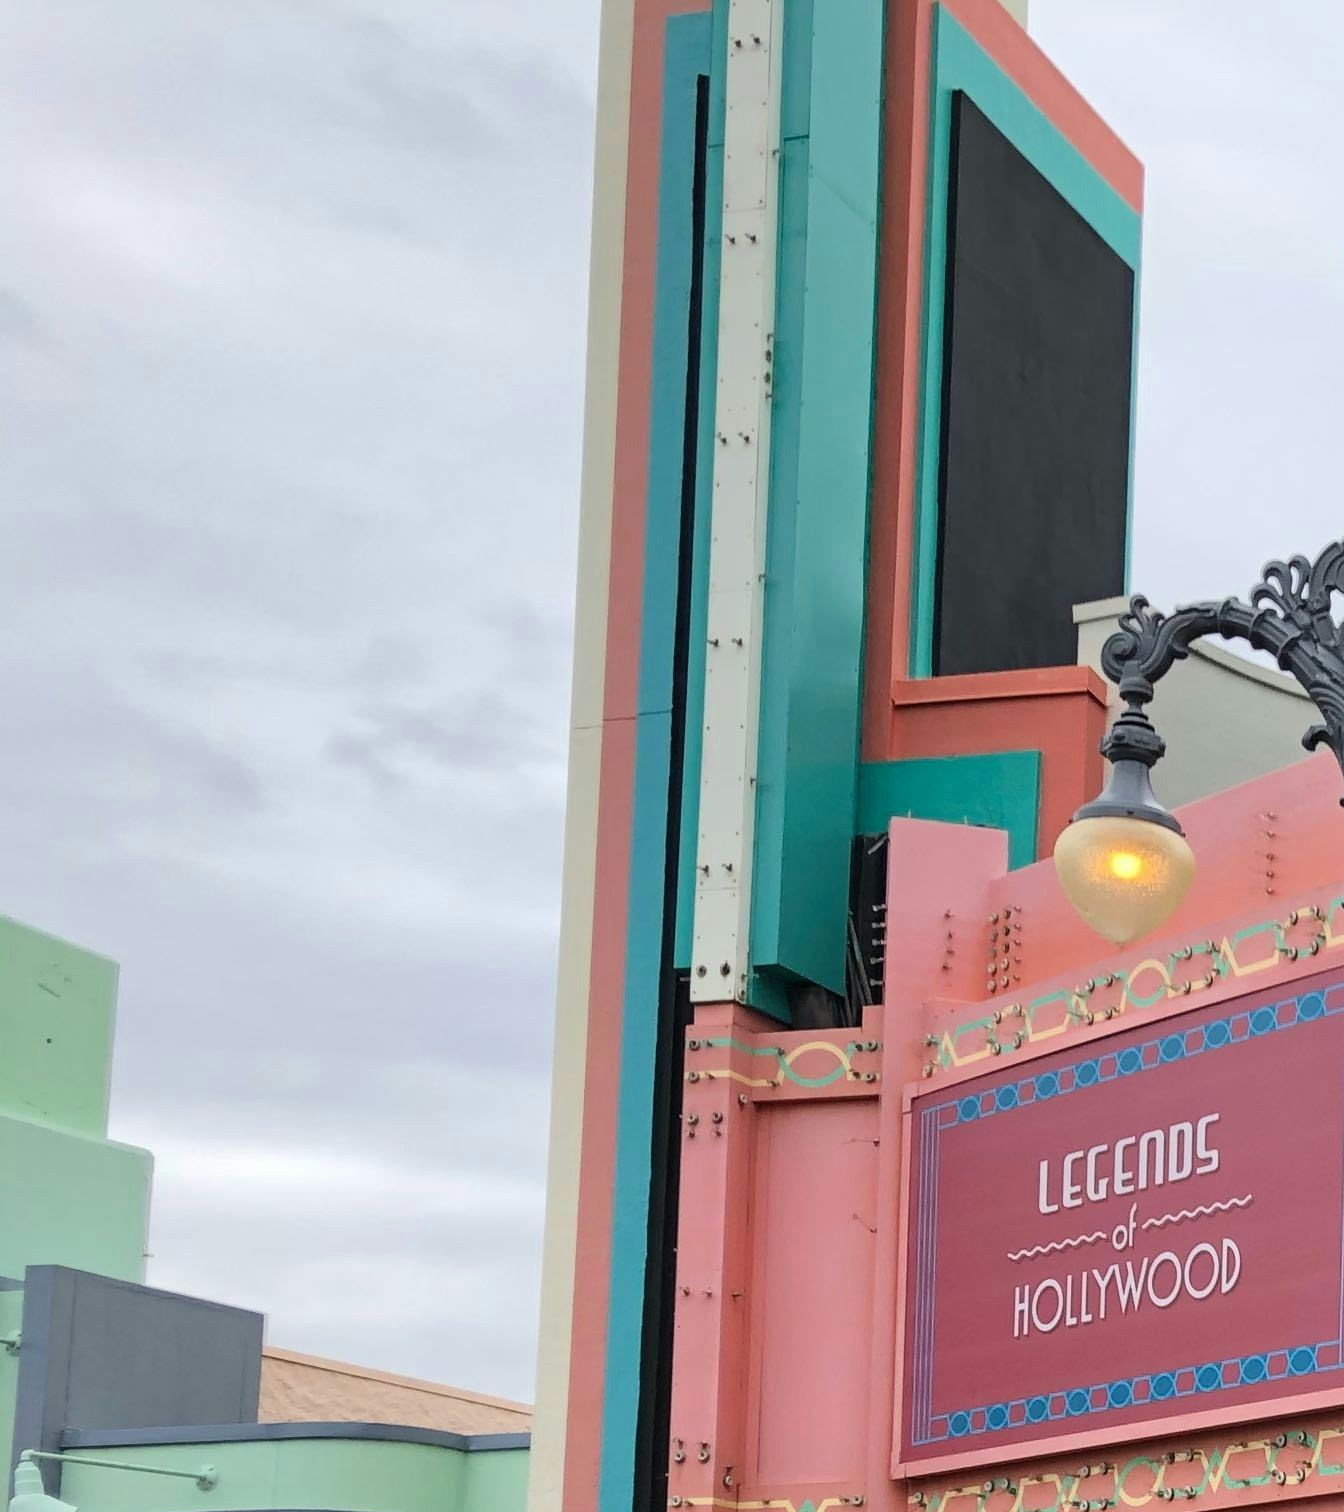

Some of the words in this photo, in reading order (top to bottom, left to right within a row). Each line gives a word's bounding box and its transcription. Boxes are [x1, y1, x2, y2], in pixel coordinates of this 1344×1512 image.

[1038, 1113, 1220, 1215] LEGENDS
[1112, 1202, 1137, 1250] of
[1013, 1238, 1241, 1338] HOLLYWOOD
